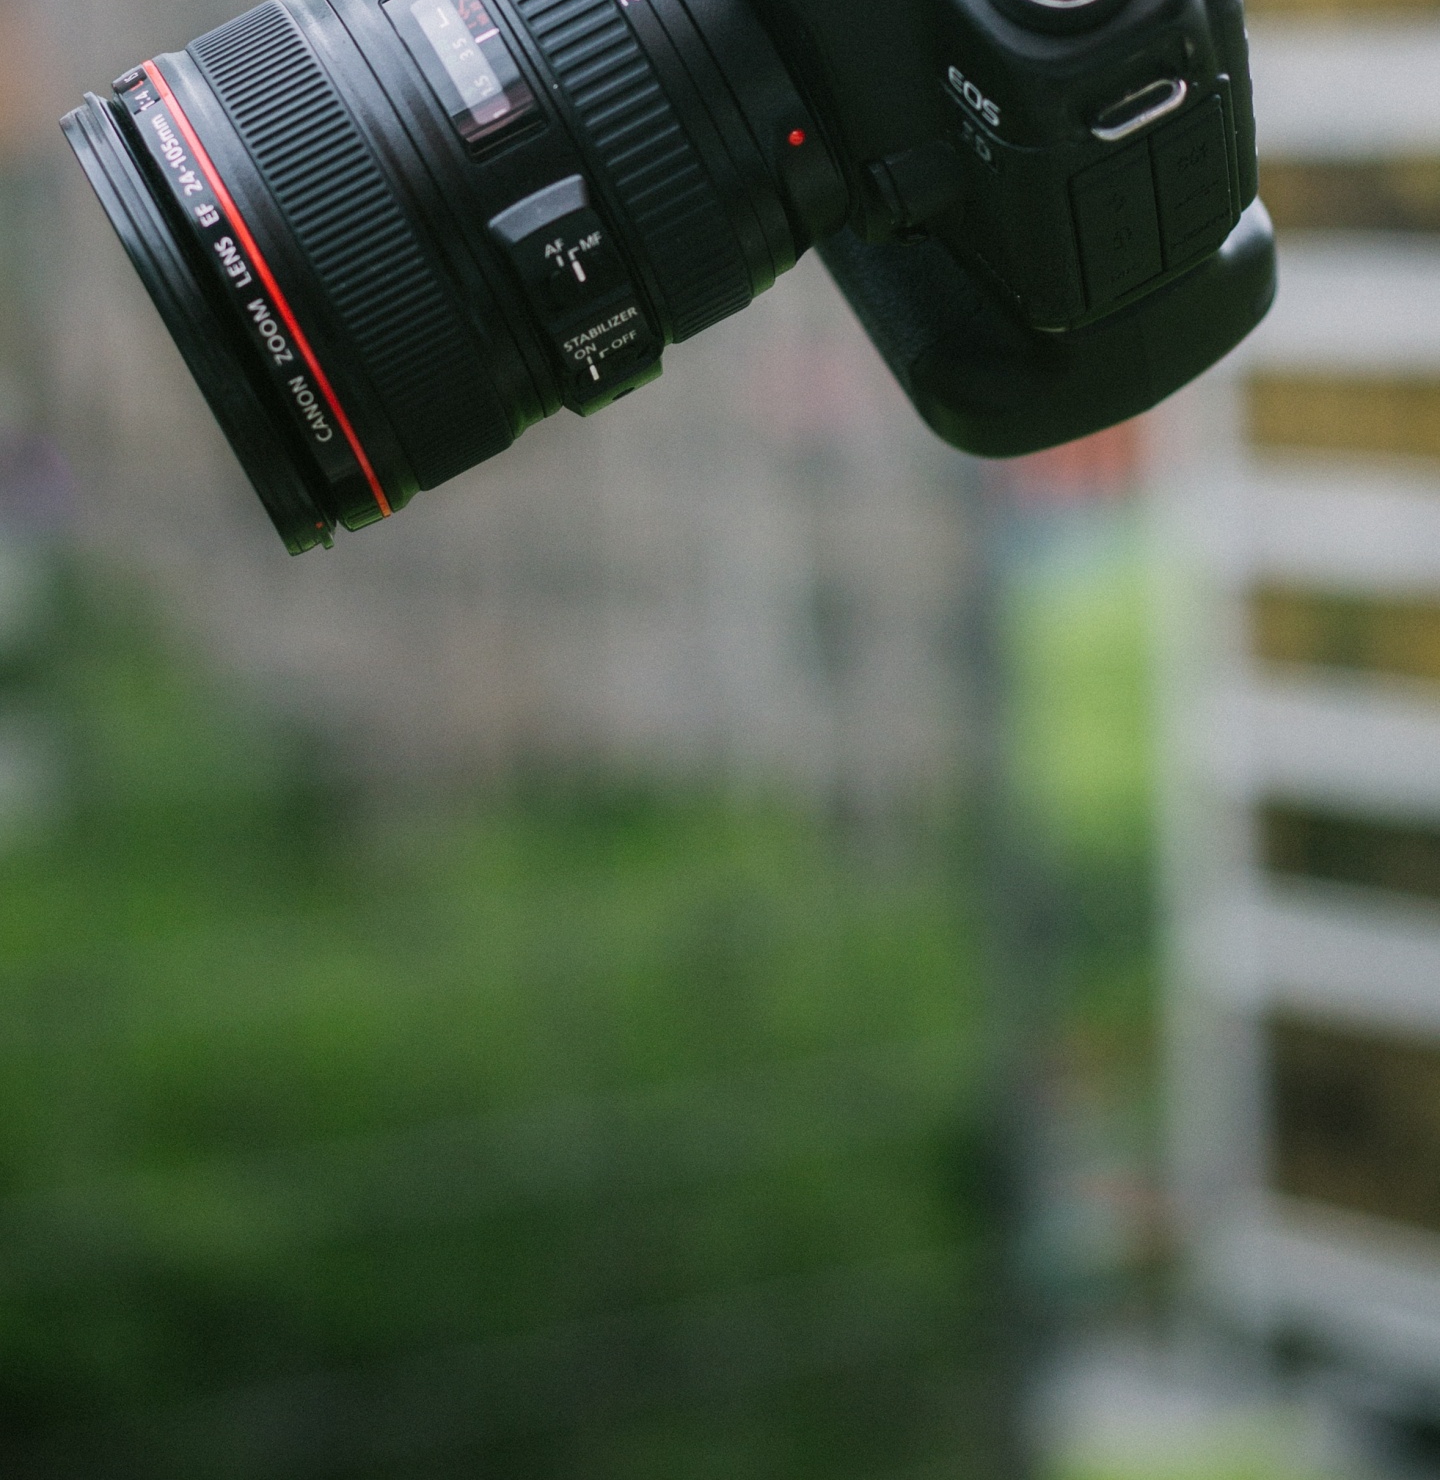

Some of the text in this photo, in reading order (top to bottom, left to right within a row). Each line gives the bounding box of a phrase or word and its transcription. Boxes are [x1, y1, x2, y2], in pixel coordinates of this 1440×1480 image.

[134, 89, 155, 112] 1:4
[948, 65, 1000, 126] EOS
[151, 113, 203, 196] 24-105mm
[194, 203, 220, 228] EF
[214, 236, 252, 288] LENS
[545, 238, 564, 258] AF
[579, 231, 602, 252] MF
[247, 298, 293, 366] ZOOM
[563, 306, 638, 352] STABILIZER
[574, 329, 637, 360] ON OFF
[288, 375, 332, 442] CANON
